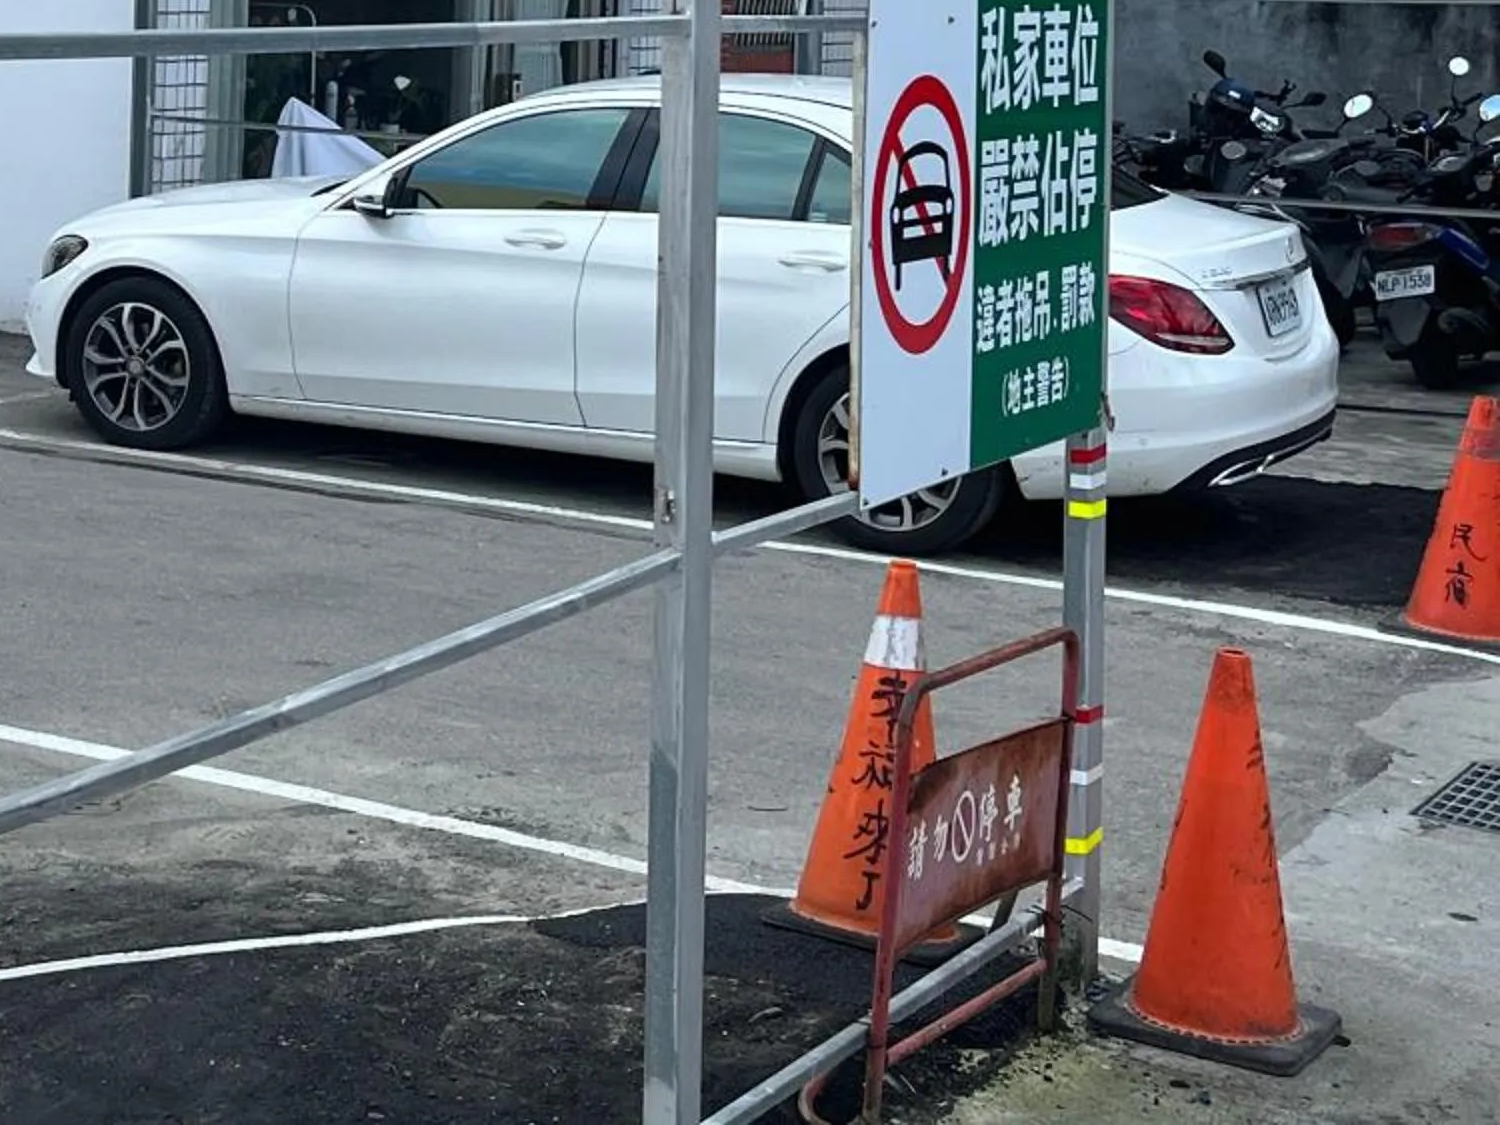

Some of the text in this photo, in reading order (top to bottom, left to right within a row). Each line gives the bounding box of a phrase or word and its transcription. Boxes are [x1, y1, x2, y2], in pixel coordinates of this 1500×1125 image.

[980, 2, 1100, 116] 私家車位
[978, 127, 1098, 248] 嚴禁佔停
